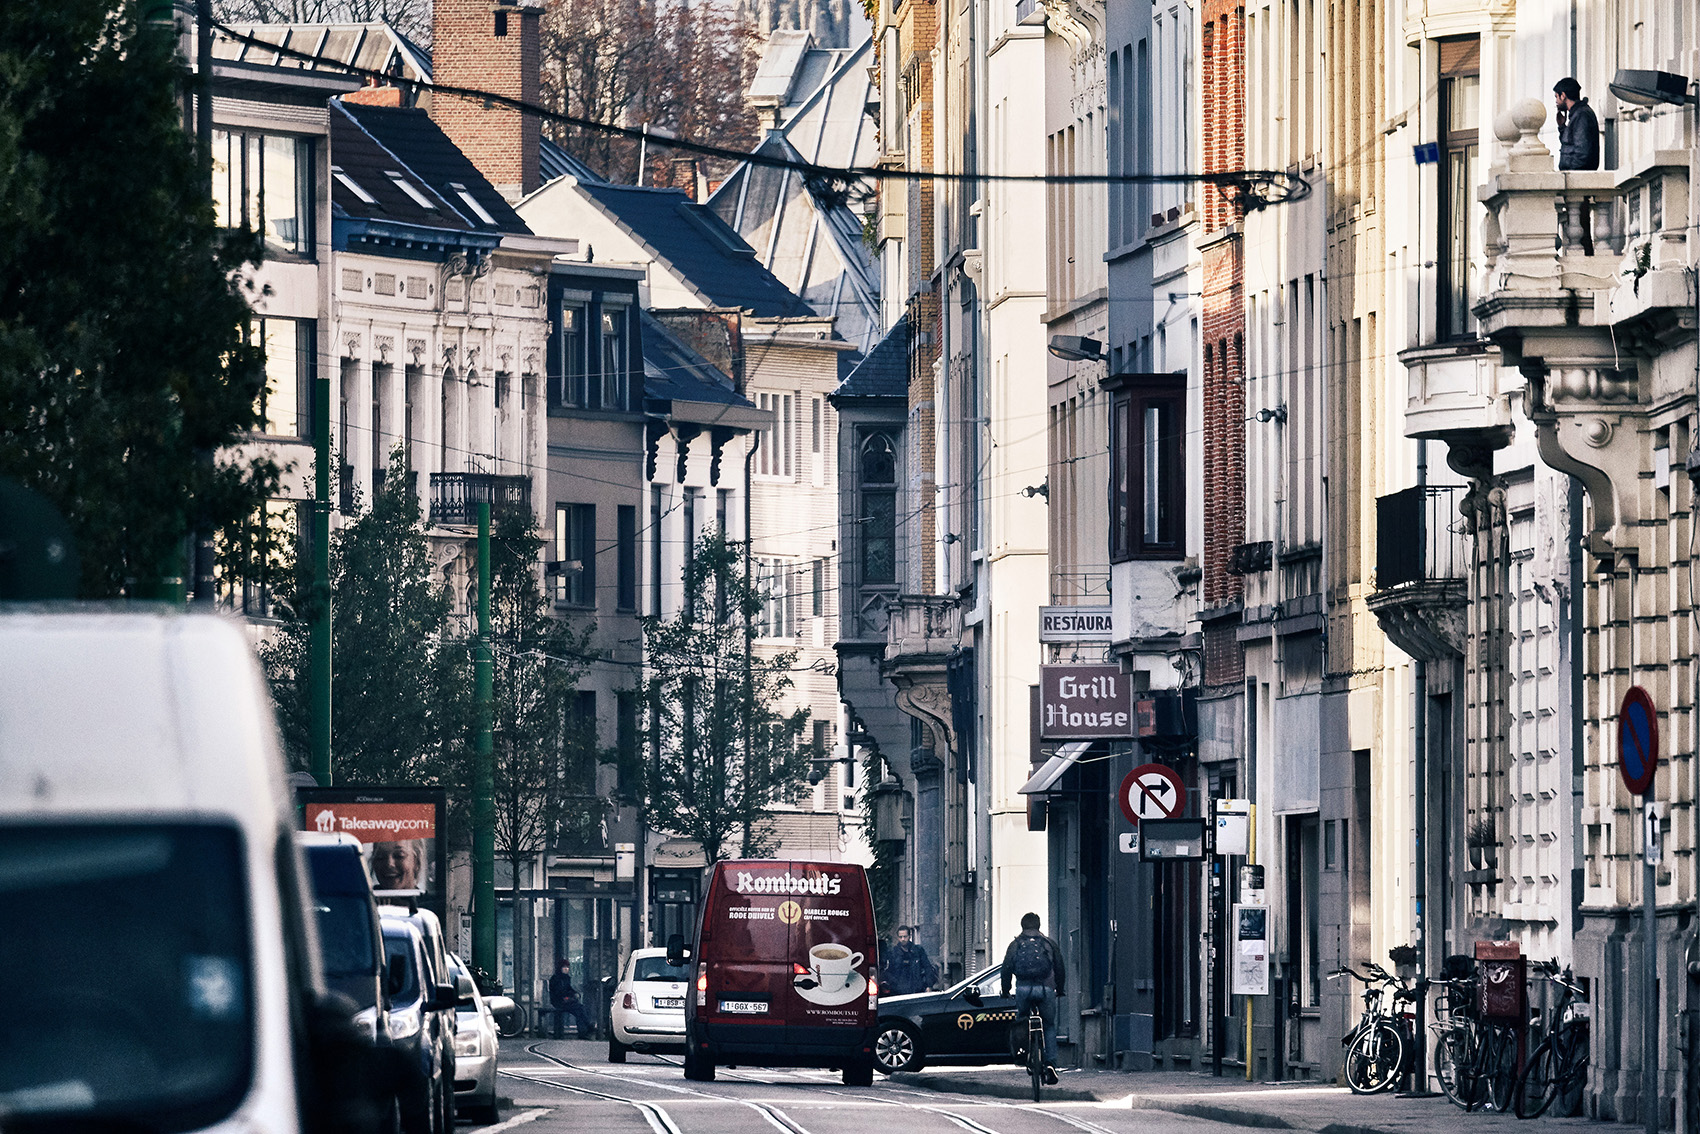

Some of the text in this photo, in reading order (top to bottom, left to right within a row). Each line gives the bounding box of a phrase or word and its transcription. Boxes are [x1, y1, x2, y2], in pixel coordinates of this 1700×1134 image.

[1044, 616, 1112, 631] RESTAURA
[1060, 676, 1117, 699] Grill
[1046, 703, 1128, 727] House
[339, 816, 429, 833] Takeaway.com
[736, 871, 842, 895] Rombouts
[747, 912, 775, 920] DUIVELS
[827, 909, 850, 917] ROUGES
